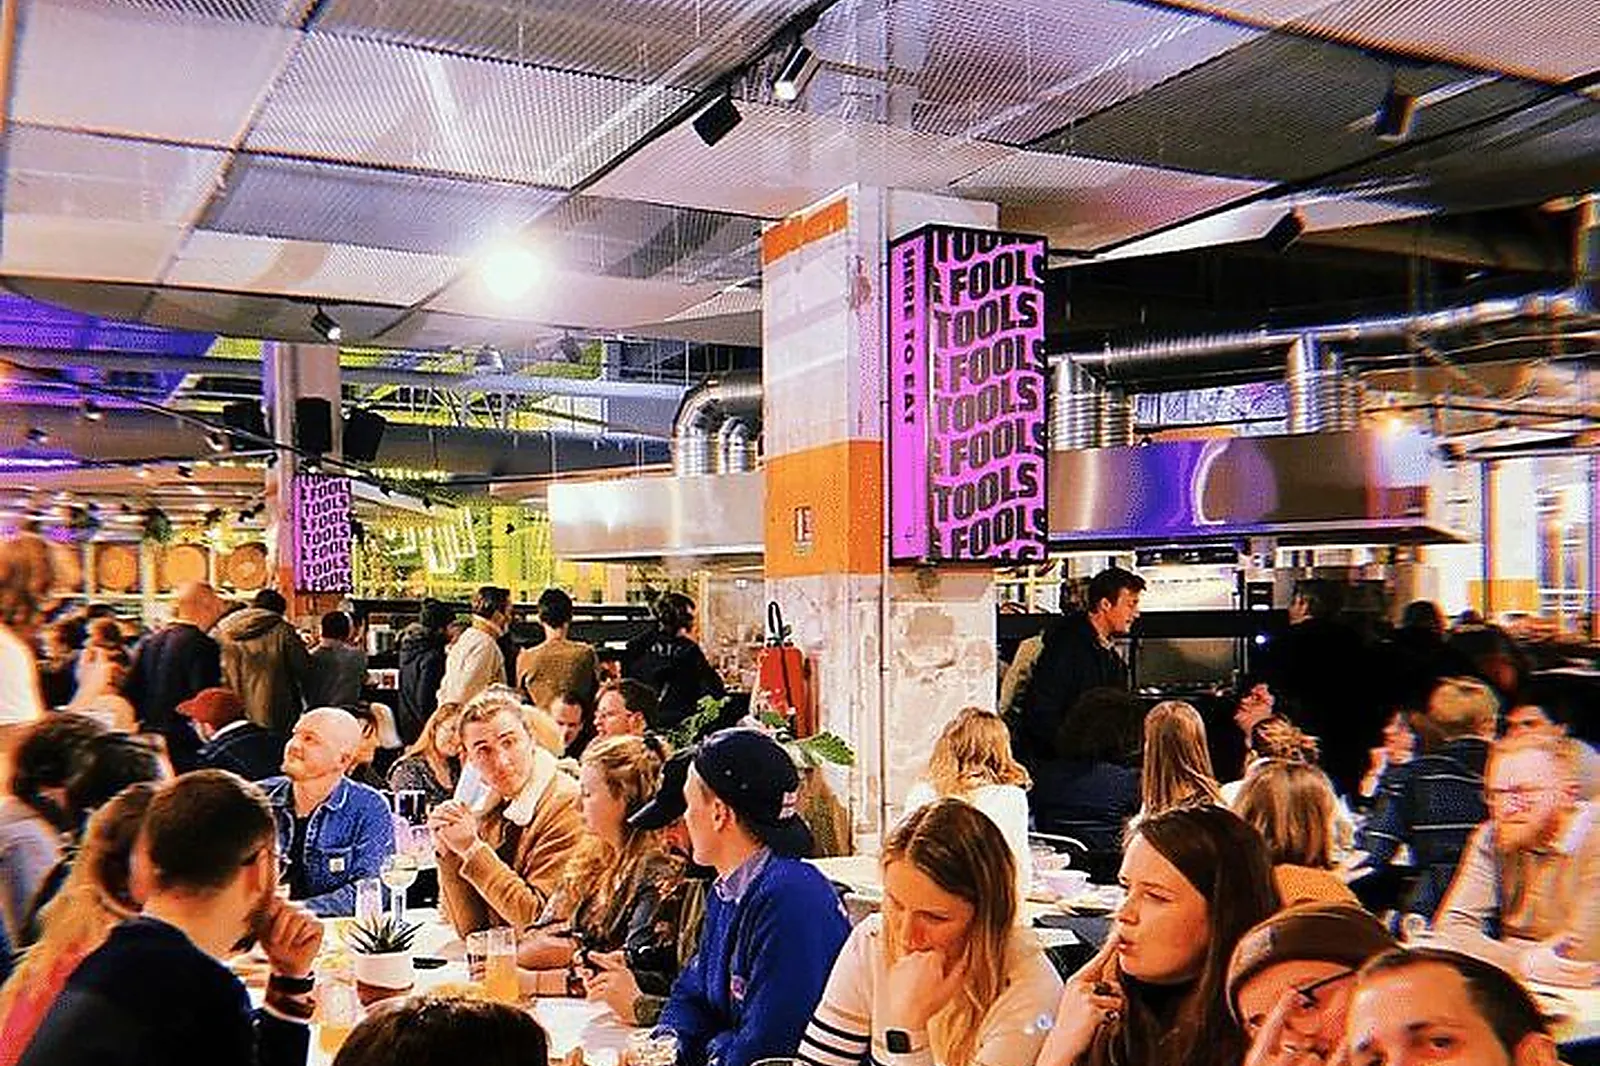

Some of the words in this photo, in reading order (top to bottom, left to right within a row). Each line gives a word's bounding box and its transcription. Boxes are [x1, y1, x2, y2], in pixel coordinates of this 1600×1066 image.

[934, 291, 1038, 348] TOOLS
[904, 329, 915, 364] TO
[904, 373, 915, 425] EAT
[934, 375, 1038, 434] TOOLS
[304, 495, 348, 517] TOOLS
[934, 462, 1038, 522] TOOLS
[304, 525, 348, 546] TOOLS
[304, 555, 348, 577] TOOLS
